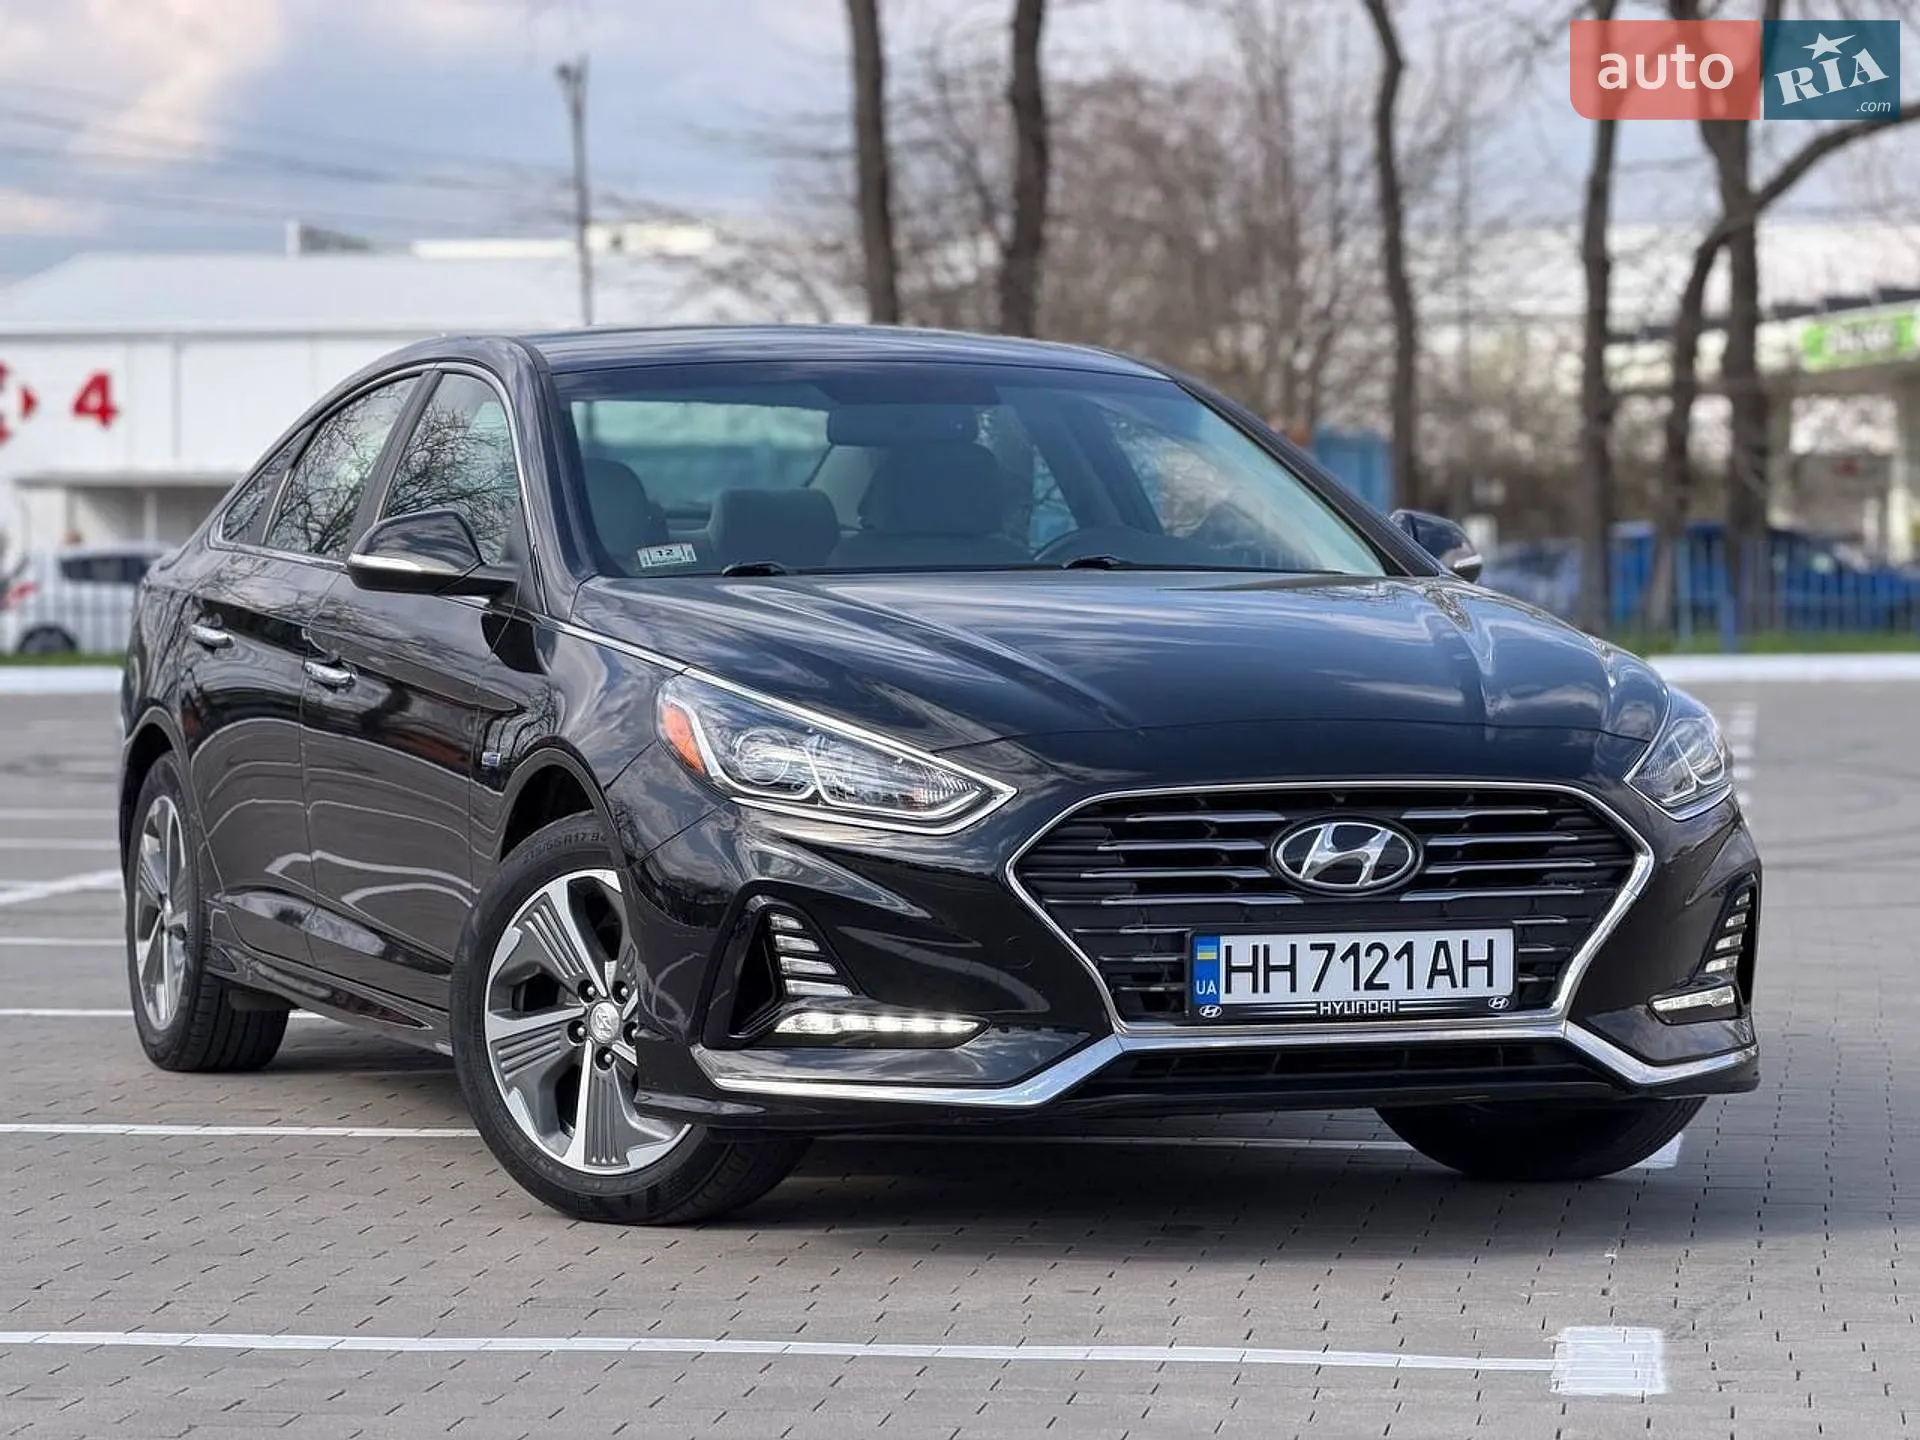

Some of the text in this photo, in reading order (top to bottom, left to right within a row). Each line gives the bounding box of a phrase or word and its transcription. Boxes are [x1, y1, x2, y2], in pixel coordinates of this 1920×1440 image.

[71, 369, 120, 431] 4
[1224, 938, 1494, 994] HH 7121 AH
[1196, 980, 1217, 995] UA
[1320, 1000, 1396, 1015] HYUNDAI
